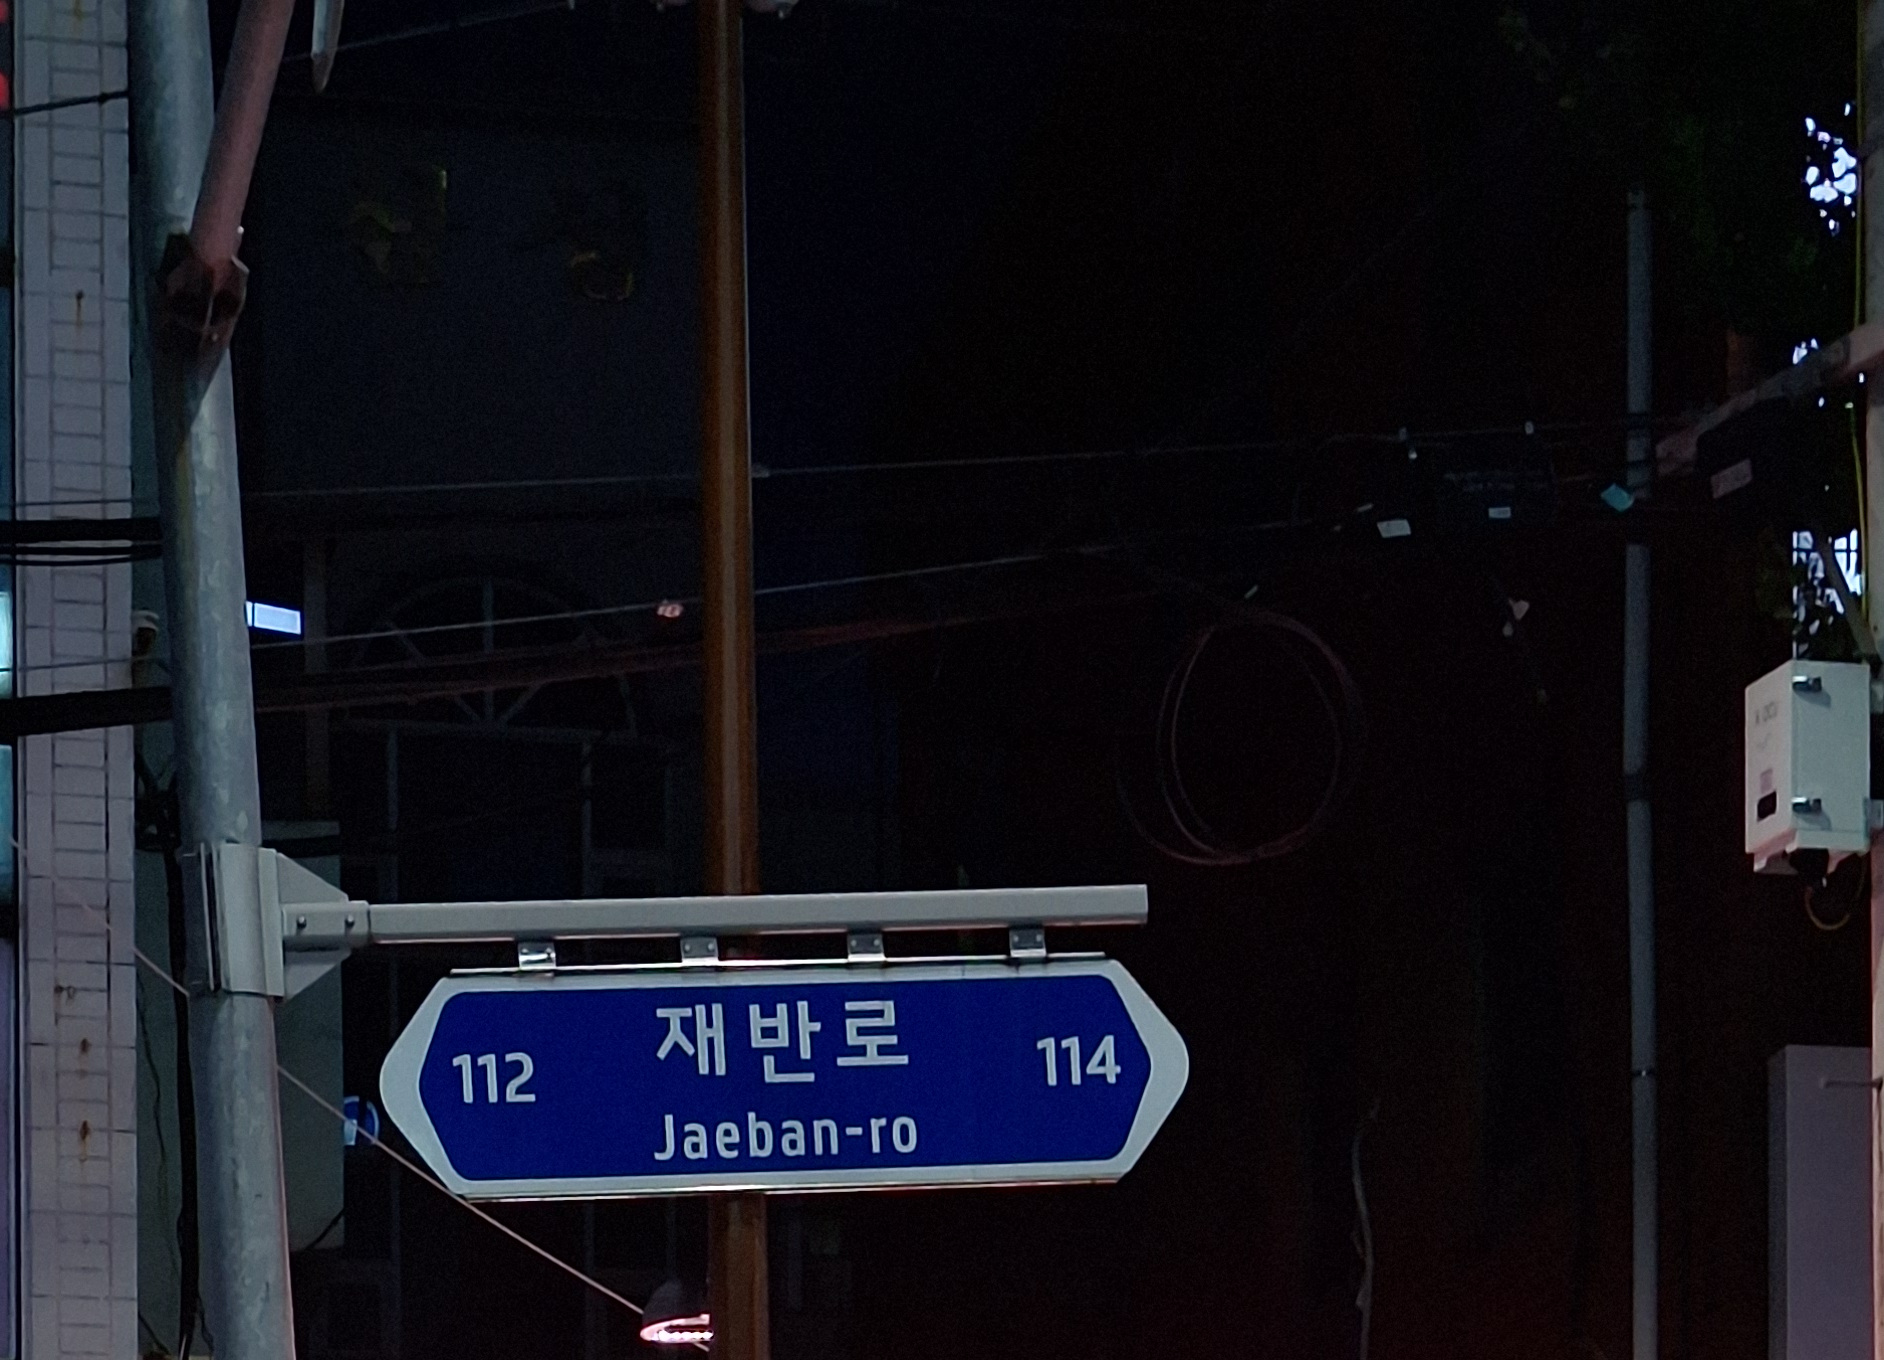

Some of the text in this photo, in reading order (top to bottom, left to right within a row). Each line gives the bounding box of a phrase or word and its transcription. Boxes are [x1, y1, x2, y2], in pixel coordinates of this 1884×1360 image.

[654, 1000, 910, 1084] 재반로
[1036, 1034, 1122, 1087] 114
[452, 1051, 537, 1105] 112
[653, 1111, 919, 1161] Jaeban-ro
